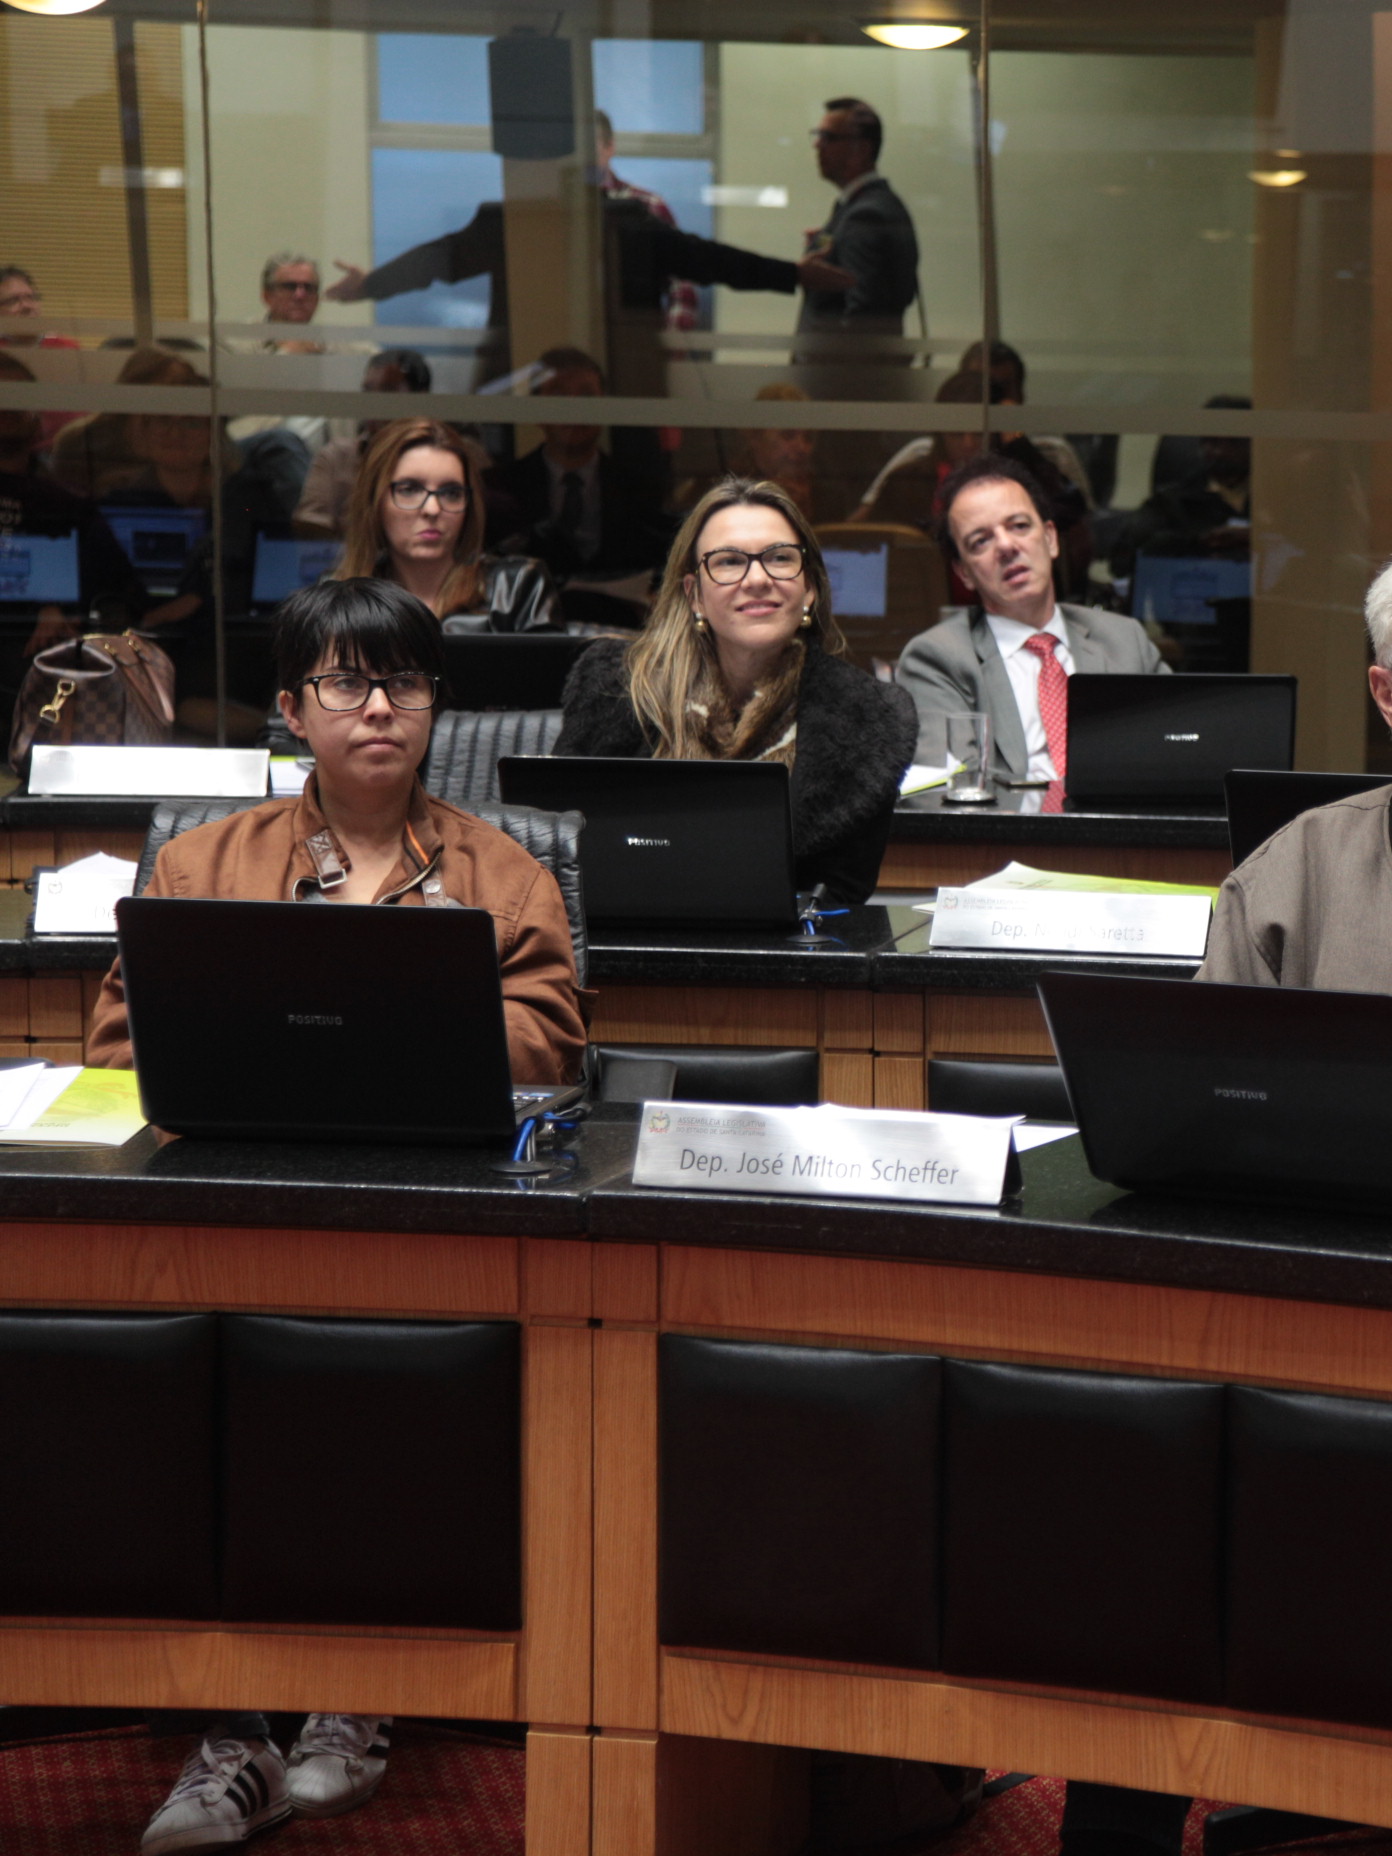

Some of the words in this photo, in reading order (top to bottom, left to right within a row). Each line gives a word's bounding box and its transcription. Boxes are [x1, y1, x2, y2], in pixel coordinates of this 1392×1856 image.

[991, 920, 1027, 940] Dep.
[287, 1014, 343, 1026] POSITIVO
[1214, 1088, 1267, 1101] POSITIVO
[680, 1148, 729, 1177] Dep.
[737, 1152, 784, 1176] José
[791, 1154, 863, 1180] Milton
[870, 1159, 960, 1185] Scheffer
